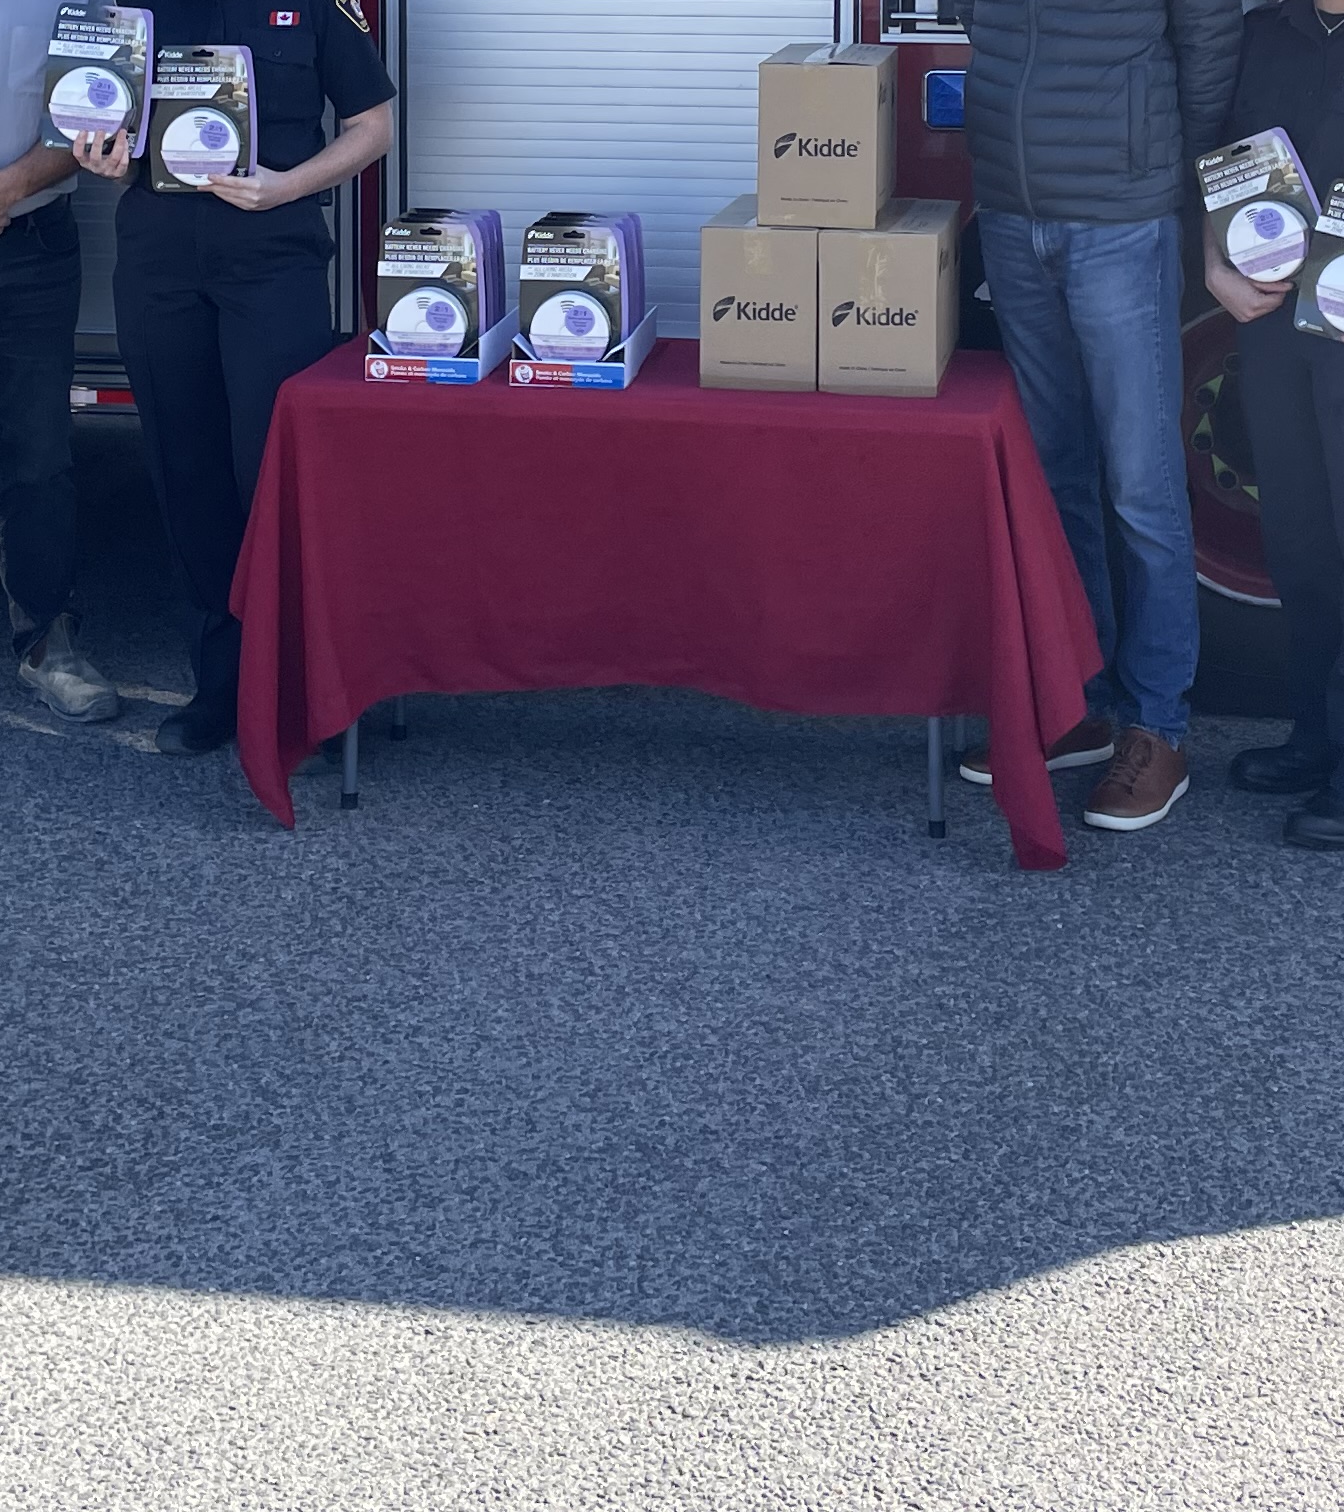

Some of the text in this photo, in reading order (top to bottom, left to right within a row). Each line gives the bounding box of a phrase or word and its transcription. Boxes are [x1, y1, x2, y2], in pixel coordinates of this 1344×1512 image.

[798, 138, 858, 158] Kidde
[736, 301, 796, 322] Kidde
[856, 306, 917, 327] Kidde
